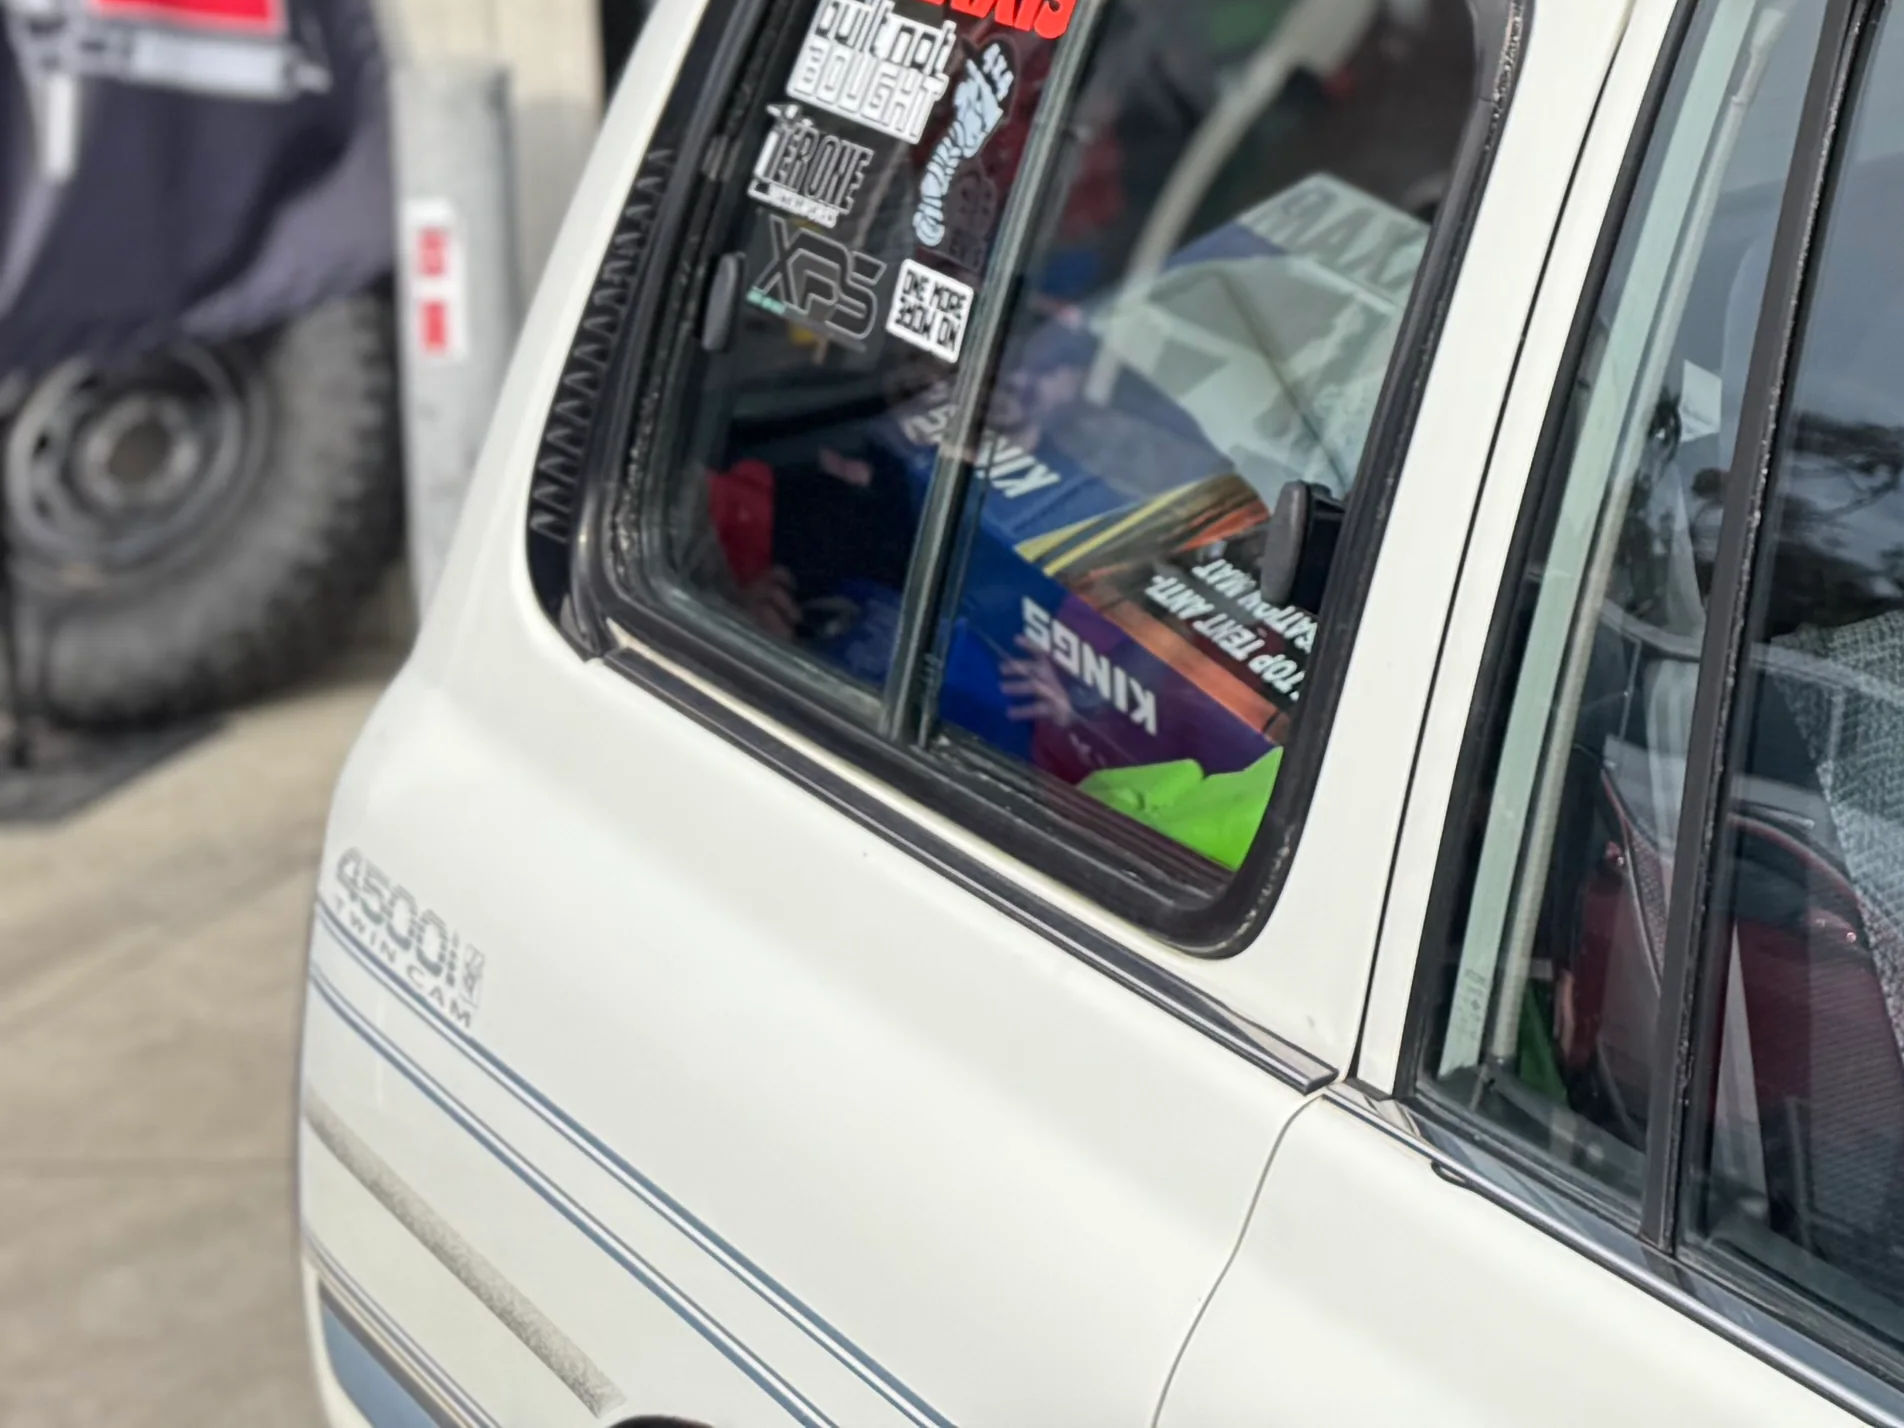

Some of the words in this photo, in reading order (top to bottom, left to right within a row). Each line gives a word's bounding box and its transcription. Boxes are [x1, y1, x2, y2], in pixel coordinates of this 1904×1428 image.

[789, 39, 949, 143] BOUGHT
[903, 268, 929, 303] ONE
[928, 280, 968, 320] MORE
[899, 404, 1061, 499] KINS
[1191, 558, 1256, 600] MAT
[1020, 597, 1159, 737] KINGS
[1192, 612, 1265, 662] TENT
[1248, 654, 1306, 695] TOP
[334, 894, 398, 965] TWIN
[406, 964, 472, 1029] CAM
